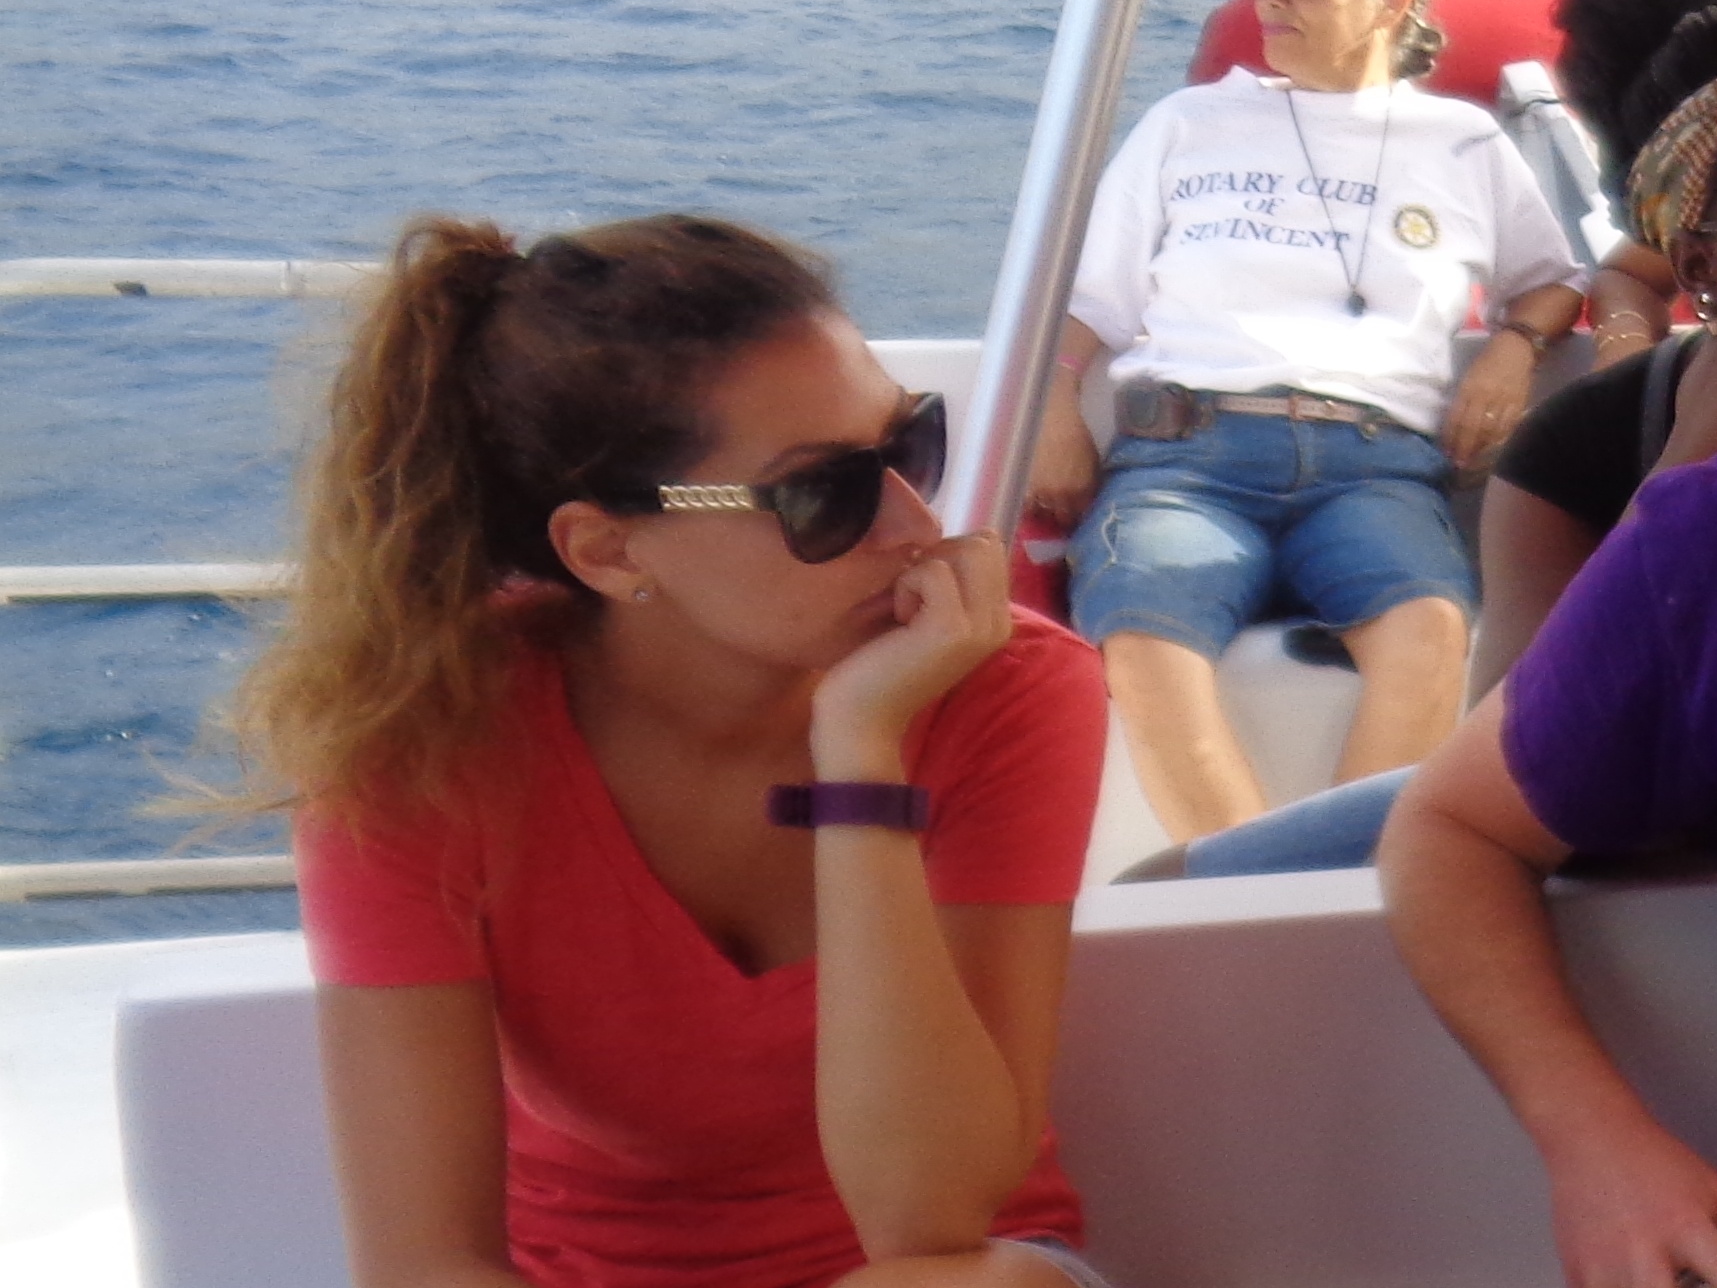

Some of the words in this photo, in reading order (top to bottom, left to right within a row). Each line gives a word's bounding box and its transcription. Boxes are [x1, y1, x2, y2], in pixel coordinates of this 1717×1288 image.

[1170, 171, 1284, 201] ROTARY
[1296, 175, 1378, 206] CLUB
[1243, 197, 1285, 216] OF
